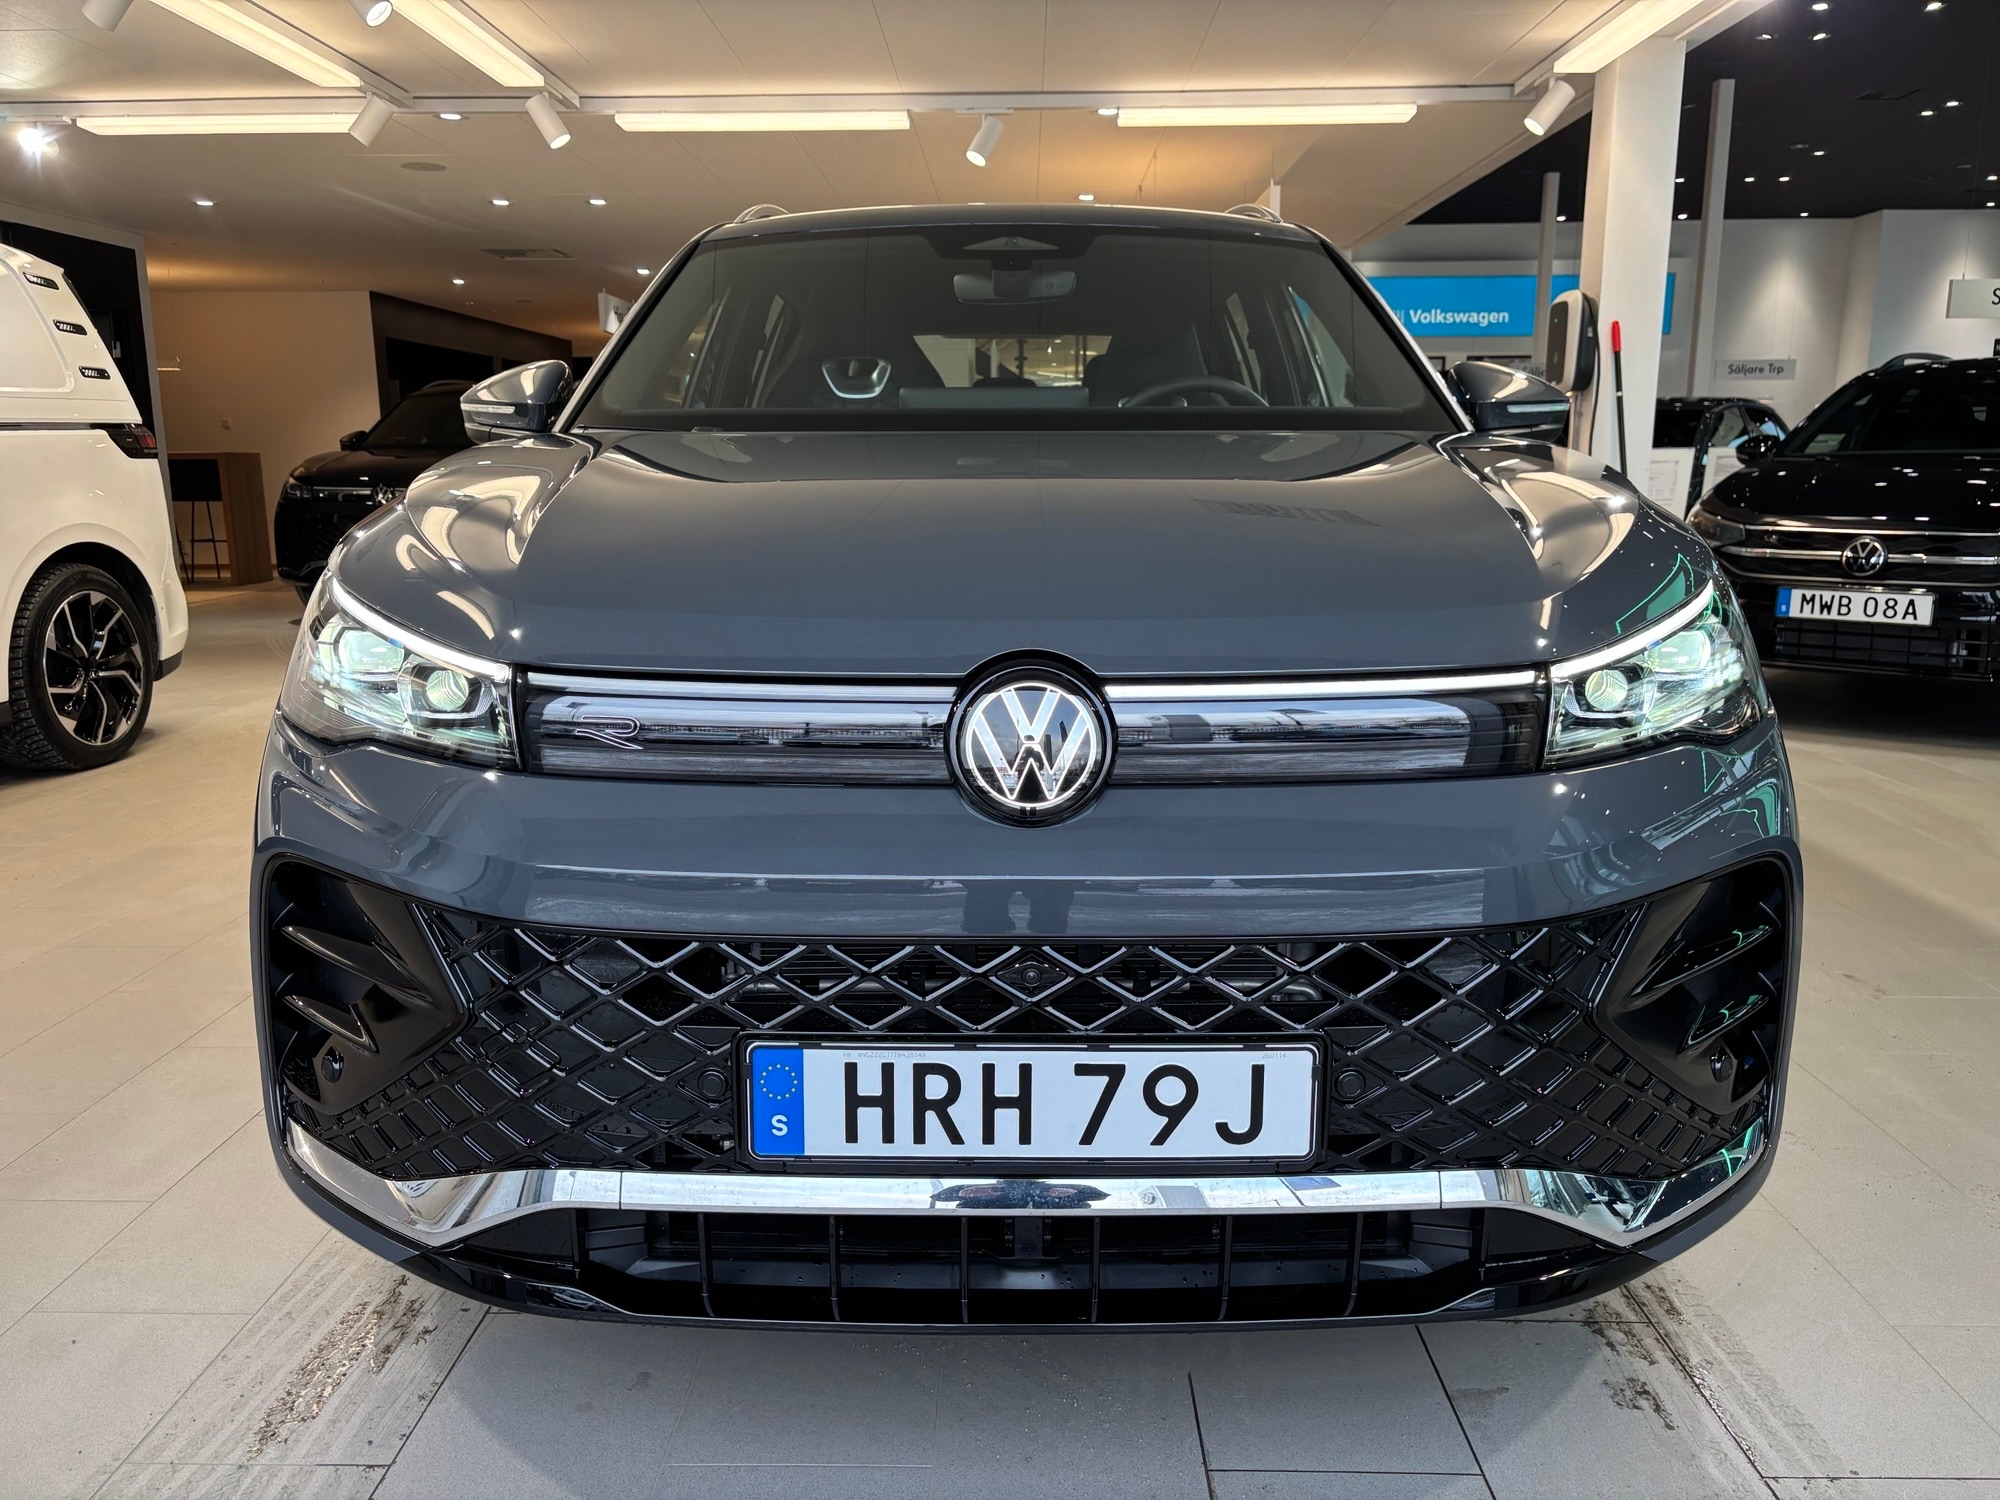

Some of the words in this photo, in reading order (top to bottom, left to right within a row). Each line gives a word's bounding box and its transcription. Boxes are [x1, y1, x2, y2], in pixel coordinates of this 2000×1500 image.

[1409, 308, 1509, 327] Volkswagen
[1728, 363, 1765, 376] Säljare
[1768, 362, 1784, 375] Trp
[1799, 593, 1852, 616] MWB
[1863, 596, 1919, 620] 08A
[845, 1062, 1033, 1146] HRH
[1073, 1063, 1265, 1146] 79J
[771, 1114, 788, 1137] S
